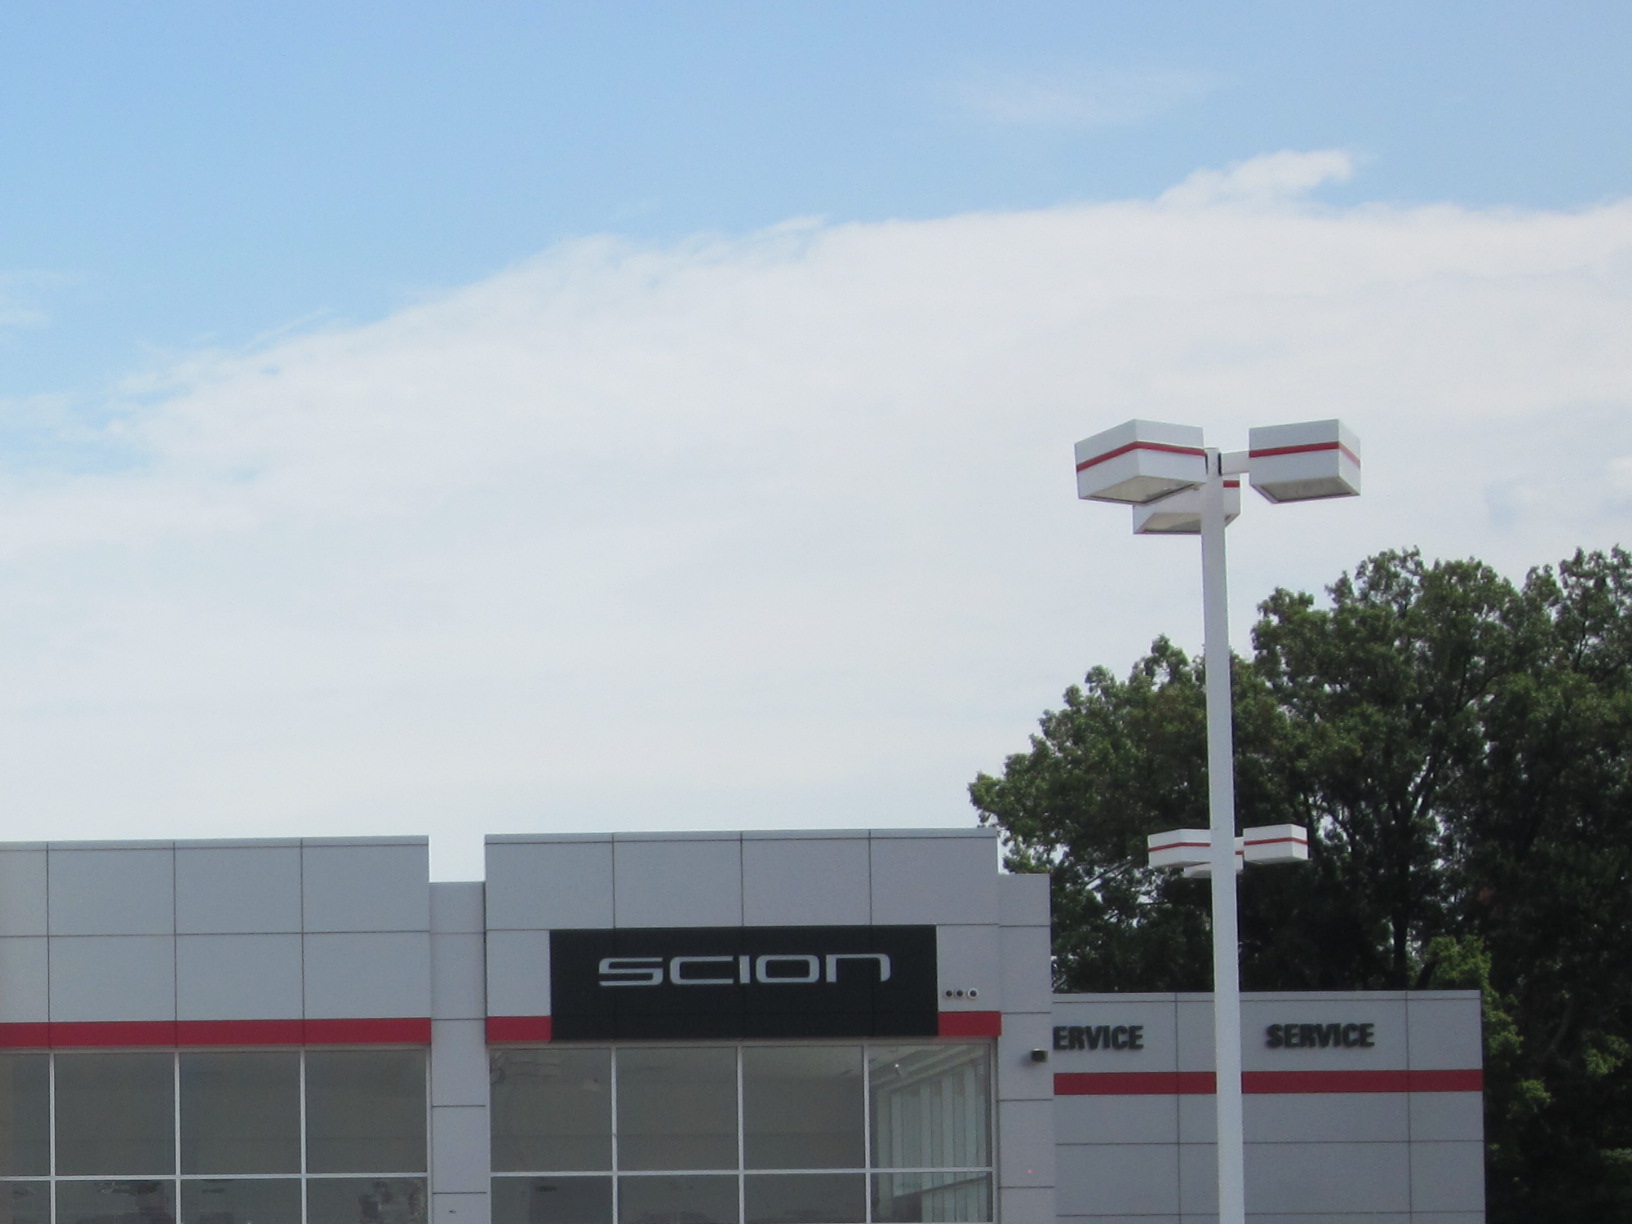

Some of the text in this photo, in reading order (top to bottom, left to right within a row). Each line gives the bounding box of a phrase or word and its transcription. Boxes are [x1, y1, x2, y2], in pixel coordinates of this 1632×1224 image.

[598, 953, 892, 987] SCION
[1053, 1025, 1144, 1050] ERVICE
[1265, 1023, 1375, 1048] SERVICE
